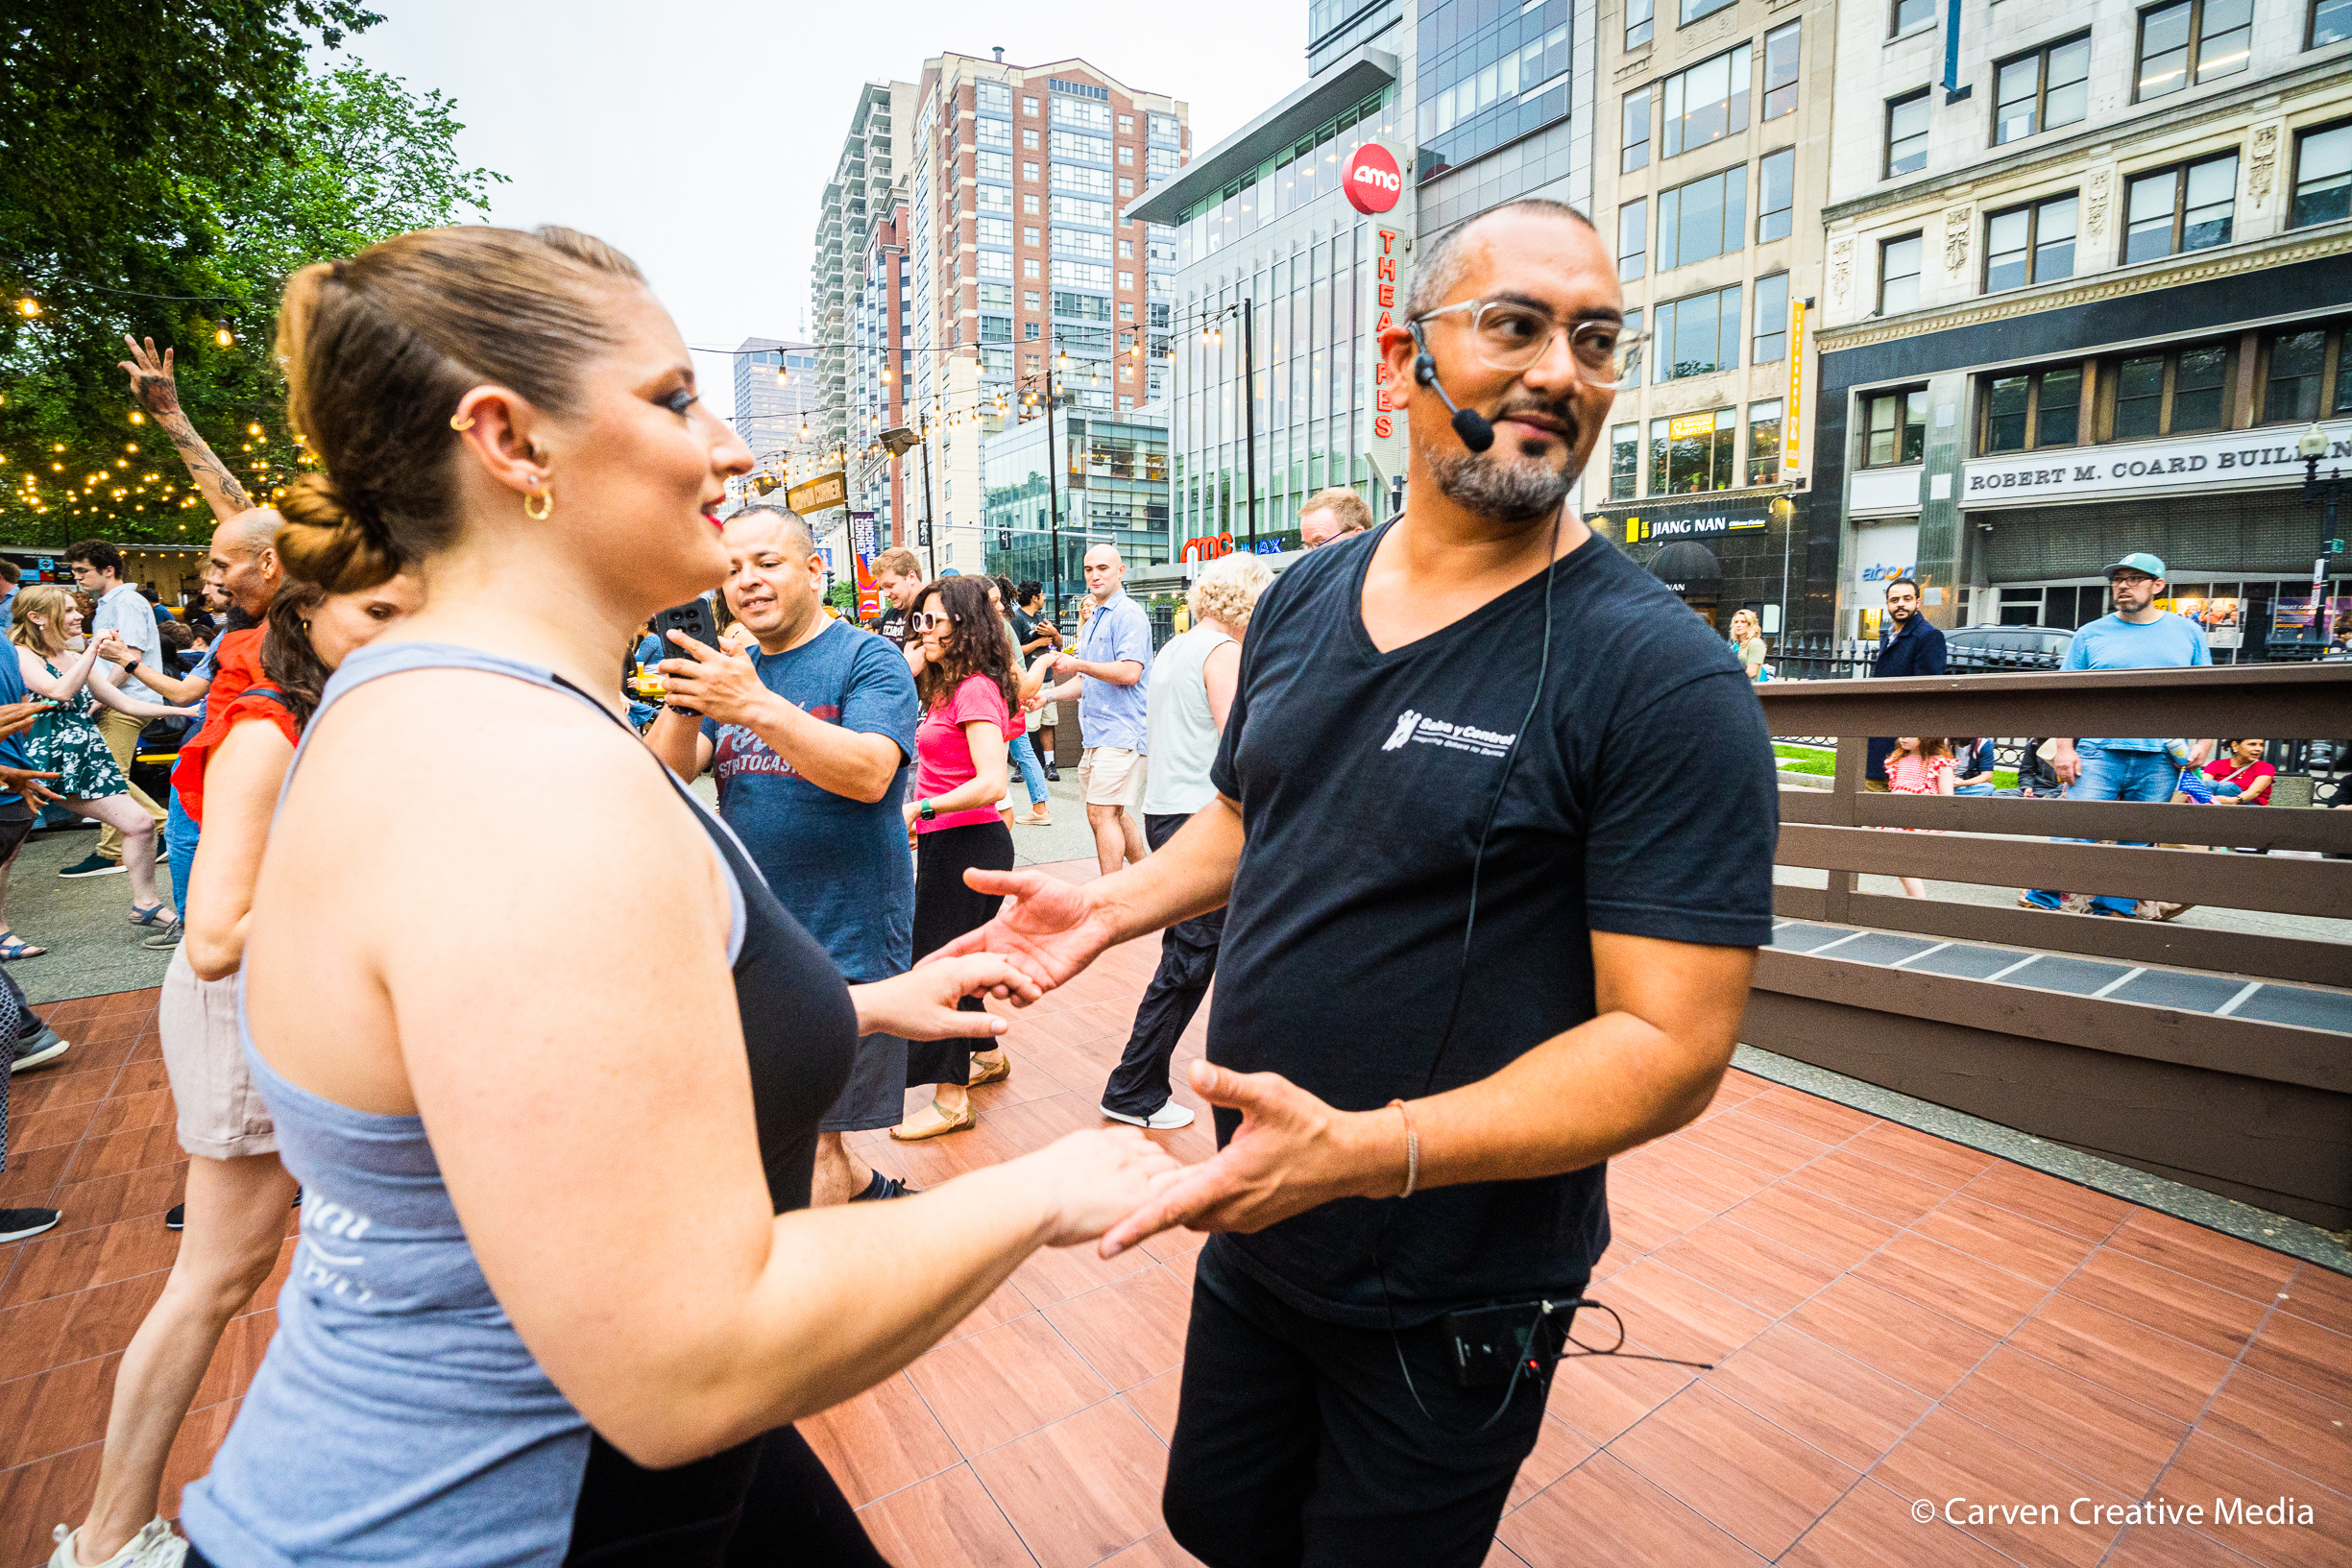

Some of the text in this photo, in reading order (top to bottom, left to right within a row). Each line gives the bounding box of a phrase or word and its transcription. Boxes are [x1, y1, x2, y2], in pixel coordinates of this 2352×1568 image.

[1353, 165, 1399, 191] amc
[1375, 229, 1396, 438] THEARES
[1970, 468, 2066, 491] ROBERT
[2073, 466, 2102, 482] M.
[2112, 454, 2208, 478] COARD
[855, 519, 866, 555] CORNER
[1651, 517, 1726, 538] JIANG NAN
[1463, 725, 1516, 746] Control
